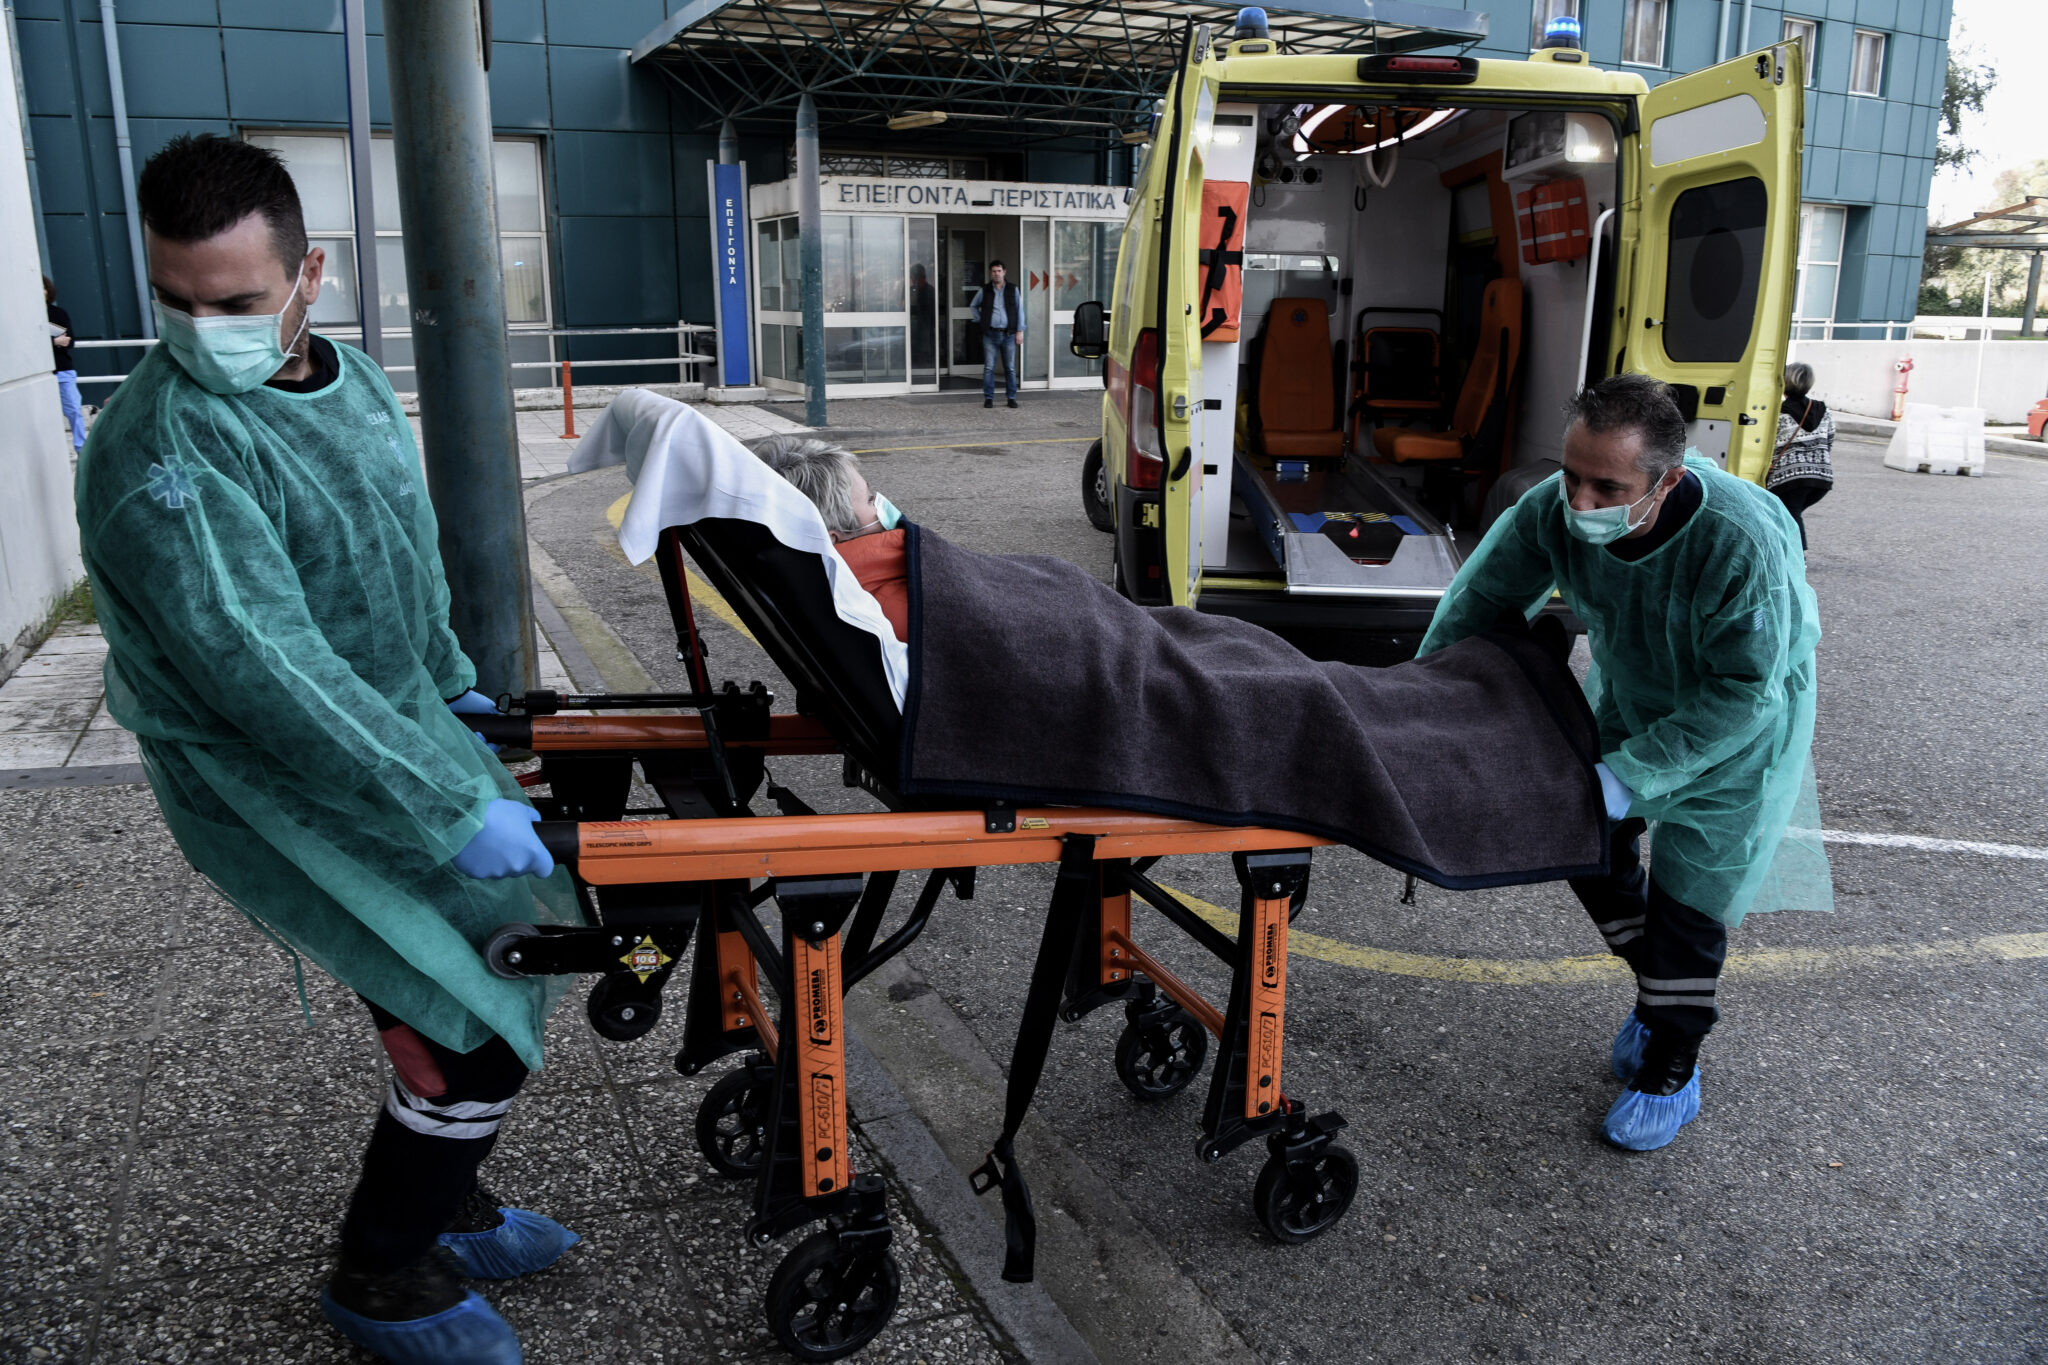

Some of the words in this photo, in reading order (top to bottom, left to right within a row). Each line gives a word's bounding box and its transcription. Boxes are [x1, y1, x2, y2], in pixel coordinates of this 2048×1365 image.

[838, 183, 968, 205] ΕΠΕΙΓΟΝΤΑ
[991, 188, 1116, 210] ΠΕΡΙΣΤΑΤΙΚΑ
[725, 199, 737, 285] ΕΠΕΙΓΟΝΤΑ
[1265, 923, 1274, 966] PROMEBA
[811, 969, 821, 1020] PROMEBA
[1262, 1018, 1274, 1068] PC-610/7
[815, 1080, 832, 1139] PC-610/7
